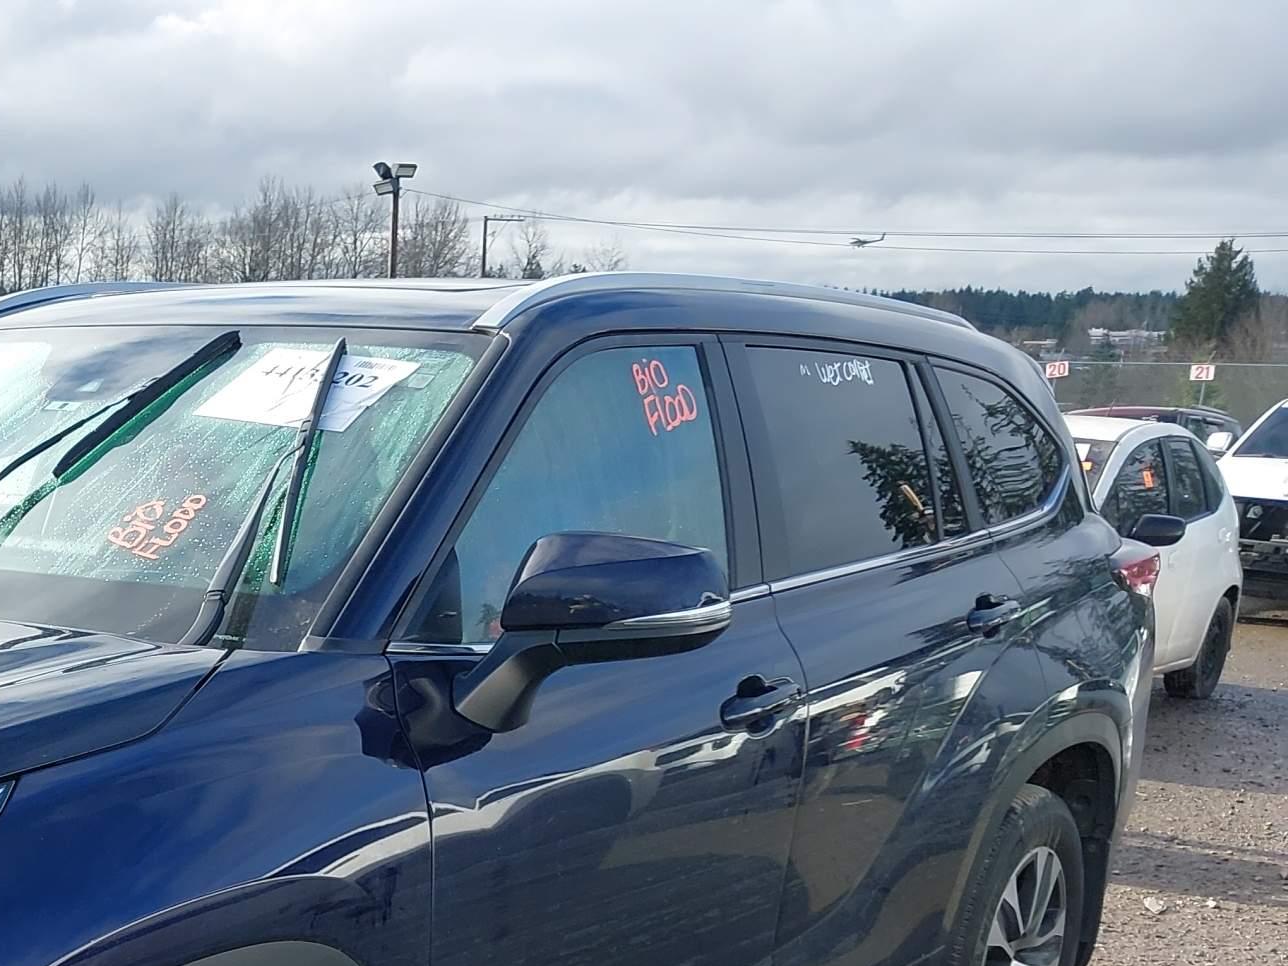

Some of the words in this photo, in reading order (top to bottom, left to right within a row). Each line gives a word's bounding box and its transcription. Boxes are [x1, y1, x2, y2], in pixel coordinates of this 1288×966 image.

[262, 364, 380, 388] 4413202
[1047, 363, 1067, 377] 20
[1194, 366, 1211, 380] 21
